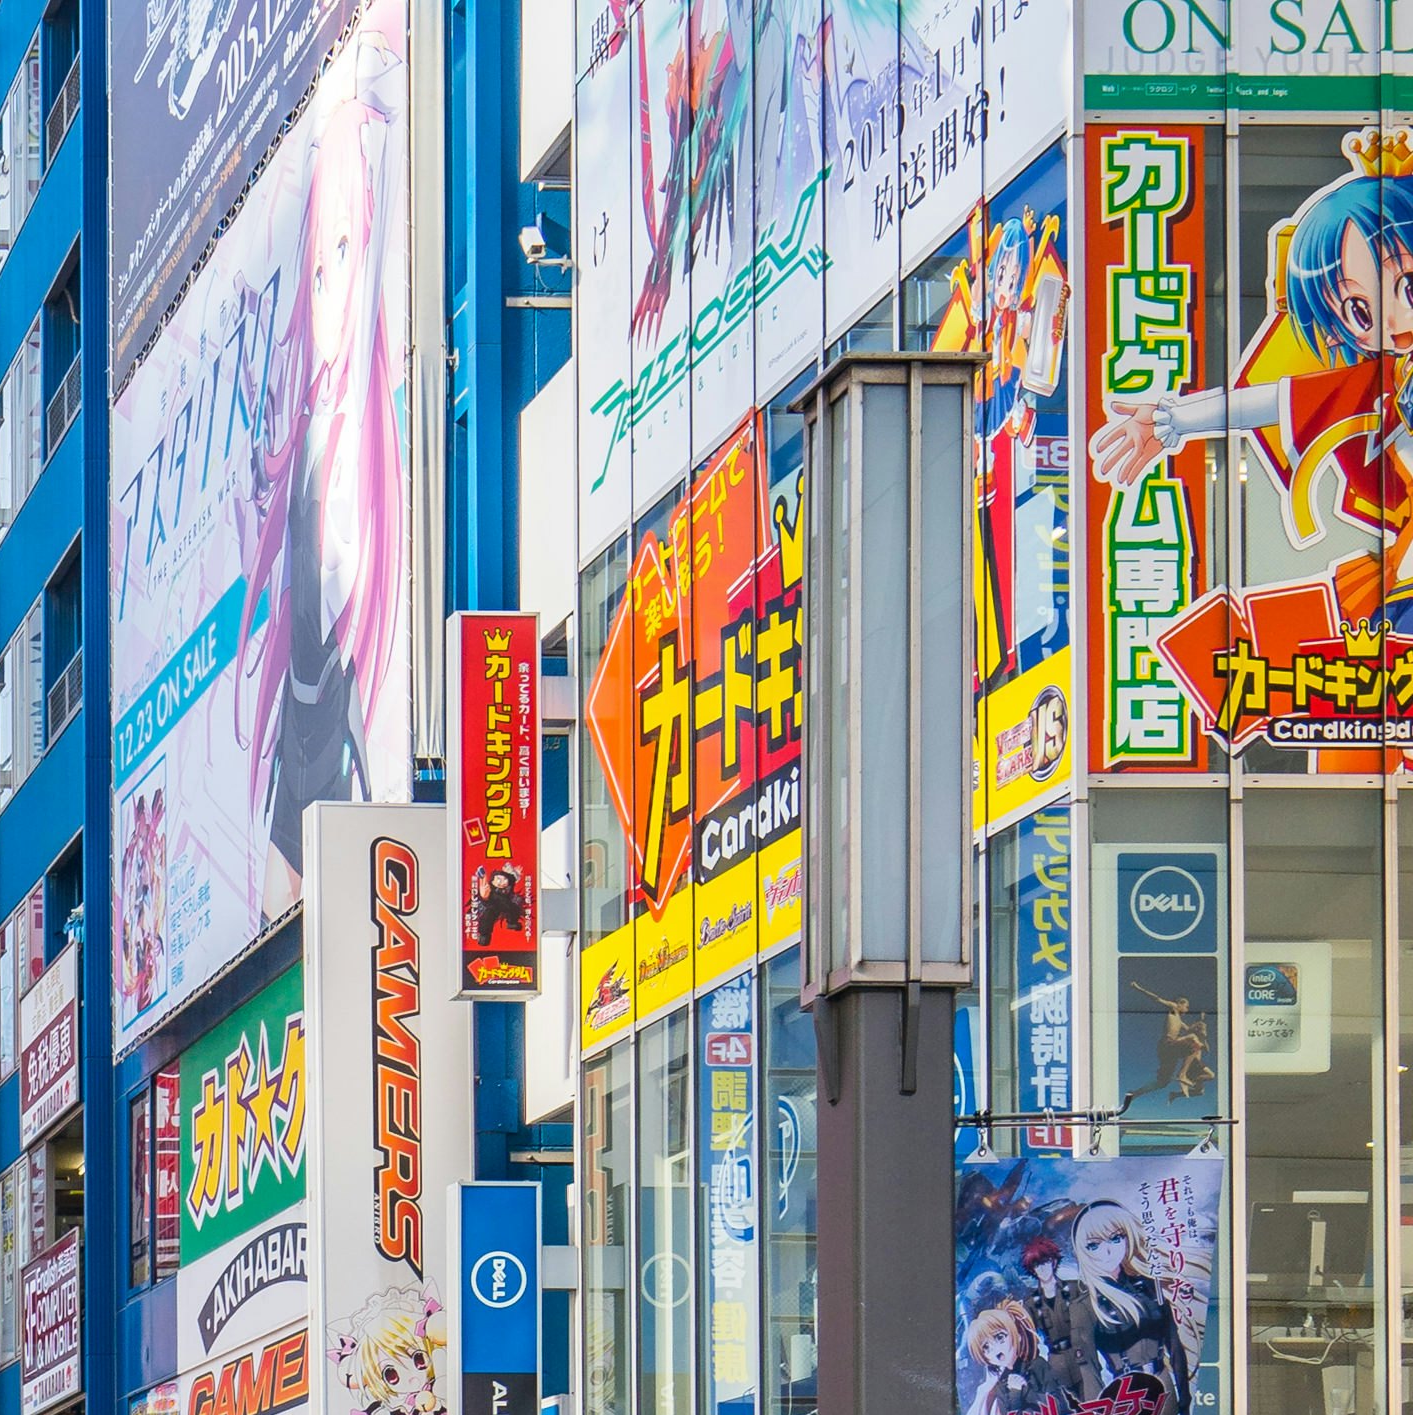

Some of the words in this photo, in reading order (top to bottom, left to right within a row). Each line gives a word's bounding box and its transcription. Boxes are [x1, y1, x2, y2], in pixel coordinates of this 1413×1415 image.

[1123, 0, 1232, 53] ON
[1256, 46, 1364, 75] YOUR
[1114, 144, 1179, 748] カードゲム専門店
[120, 719, 153, 771] 12.23
[158, 685, 181, 728] ON
[183, 622, 218, 694] SALE
[485, 654, 513, 859] カードキングダム
[1139, 892, 1197, 912] DELL
[1248, 989, 1275, 1001] CORE
[1251, 973, 1274, 983] intel
[372, 836, 423, 1281] GAMERS
[1156, 1176, 1194, 1328] 君を守りたい
[491, 1258, 506, 1302] DELL
